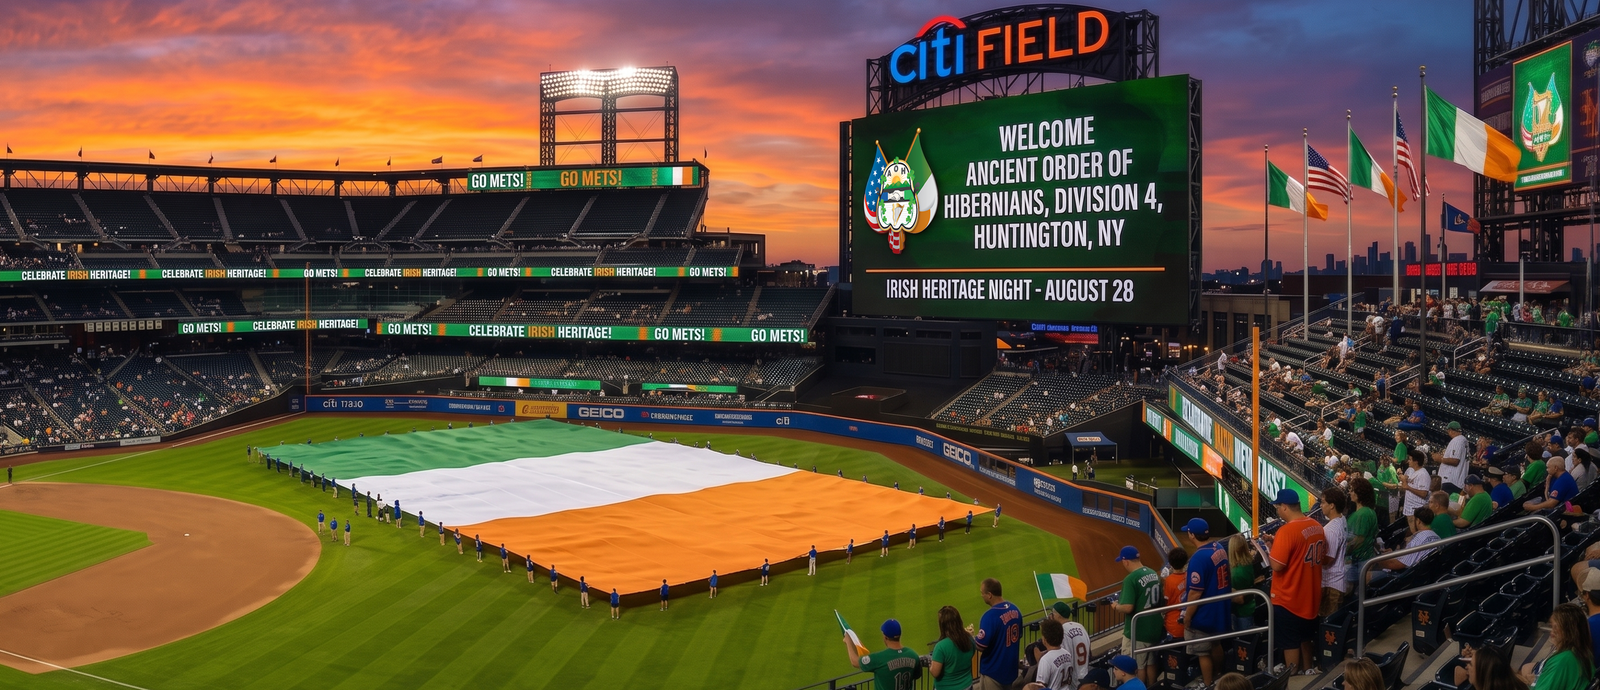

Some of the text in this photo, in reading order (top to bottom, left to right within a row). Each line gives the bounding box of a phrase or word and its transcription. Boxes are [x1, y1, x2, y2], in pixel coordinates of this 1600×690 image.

[890, 10, 1110, 83] citi FIELD
[999, 115, 1095, 153] WELCOME
[966, 148, 1134, 187] ANCIENT ORDER OF
[471, 172, 524, 188] GO METS!
[560, 169, 622, 187] GO METS!
[944, 182, 1164, 219] HIBERNIANS, DIVISION 4,
[974, 218, 1126, 251] HUNTINGTON, NY
[21, 269, 131, 281] CELEBRATE IRISH HERITAGE!
[161, 269, 267, 279] CELEBRATE IRISH HERITAGE!
[303, 269, 338, 278] GO METS!
[364, 268, 457, 278] CELEBRATE IRISH HERITAGE!
[487, 268, 521, 277] GO METS!
[551, 268, 656, 277] CELEBRATE IRISH HERITAGE!
[689, 268, 727, 277] GO METS!
[886, 280, 919, 300] IRISH
[922, 280, 986, 301] HERITAGE
[988, 280, 1032, 301] NIGHT
[1044, 280, 1109, 302] AUGUST
[1112, 279, 1135, 303] 28
[182, 323, 222, 333] GO METS!
[253, 319, 359, 331] CELEBRATE IRISH HERITAGE!
[388, 324, 432, 335] GO METS!
[469, 325, 612, 339] CELEBRATE IRISH HERITAGE!
[654, 328, 705, 341] GO METS!
[751, 329, 804, 342] GO METS!
[578, 407, 624, 418] GEICO
[943, 442, 971, 466] GEICO
[1076, 642, 1087, 666] 9
